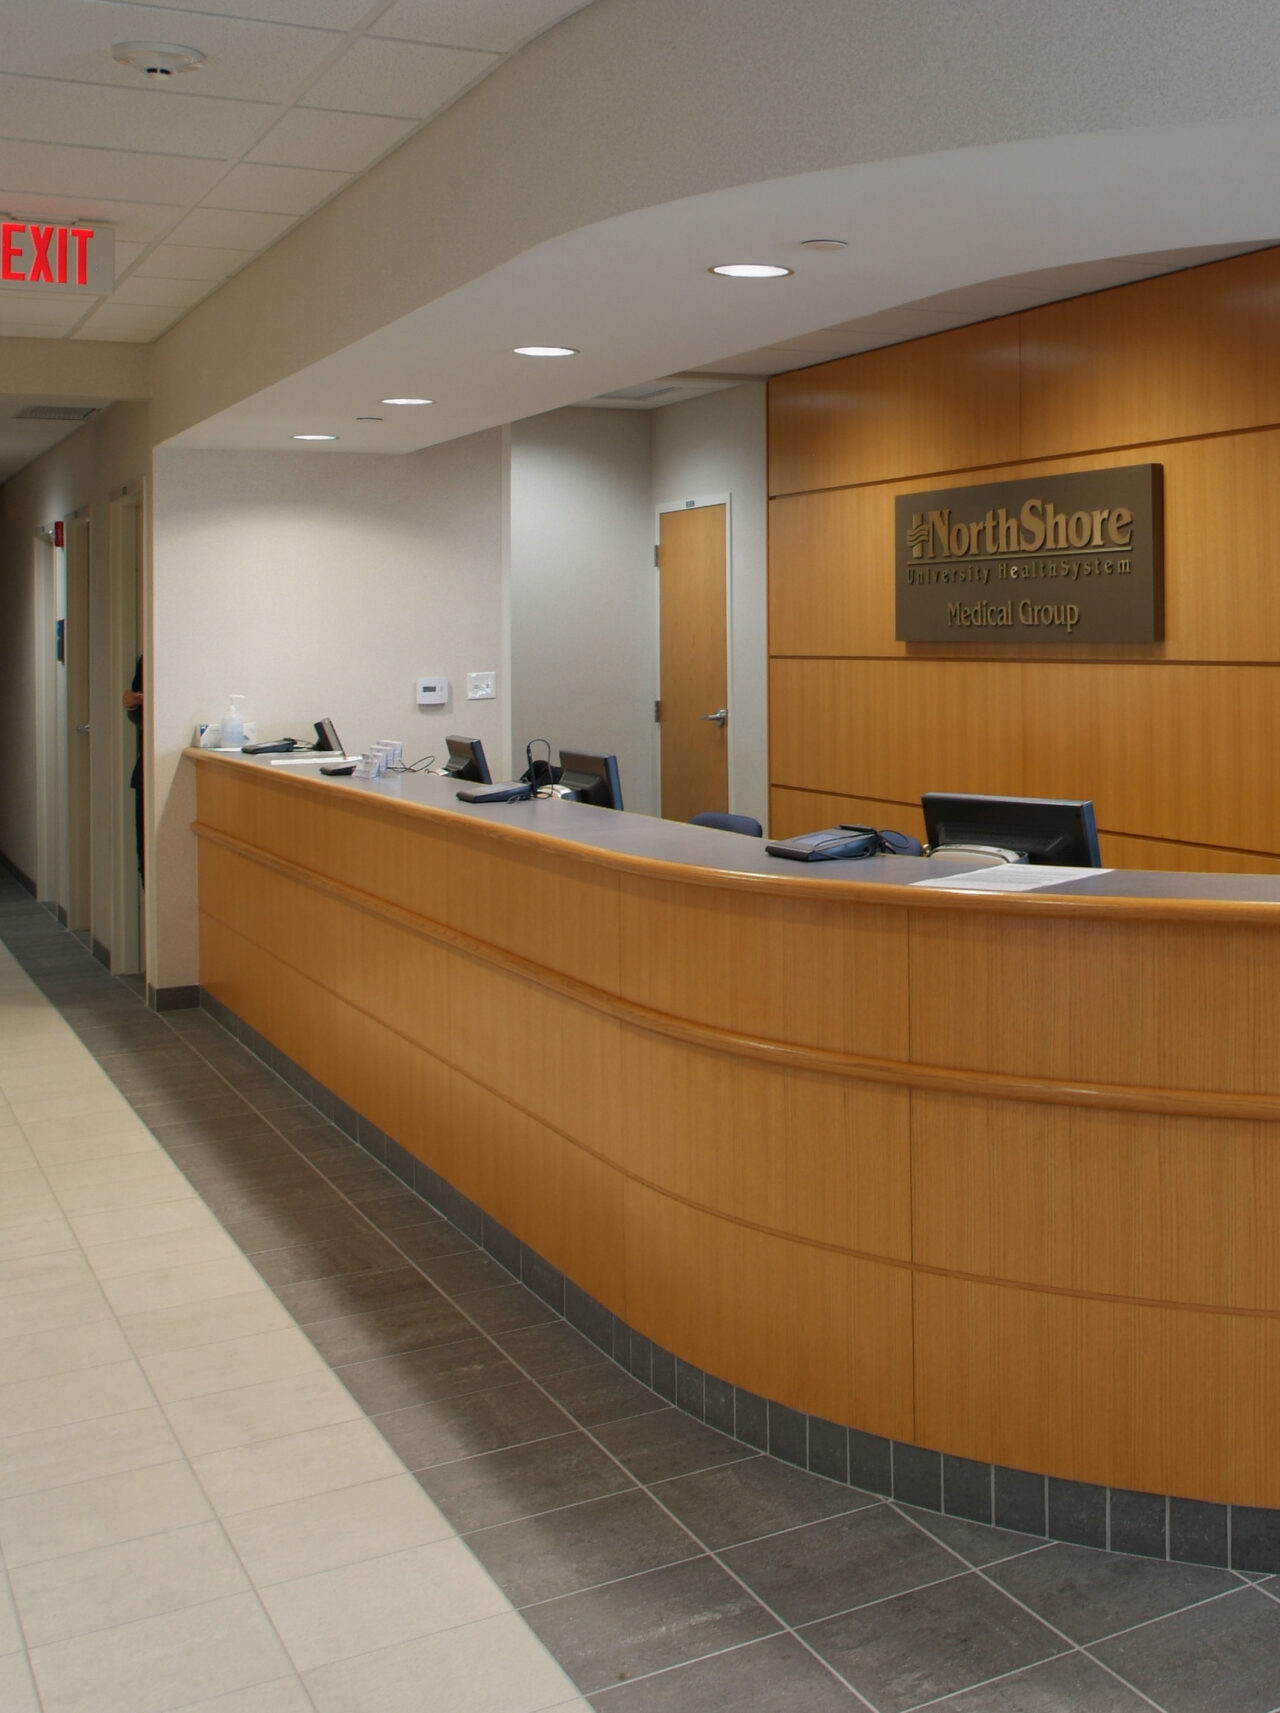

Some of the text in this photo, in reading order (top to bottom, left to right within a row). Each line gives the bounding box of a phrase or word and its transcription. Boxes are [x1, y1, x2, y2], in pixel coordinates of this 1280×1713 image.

[1, 222, 94, 285] EXIT
[926, 498, 1132, 558] NorthShore
[906, 556, 1132, 584] University HealthSystem
[946, 599, 1081, 632] Medical Group
